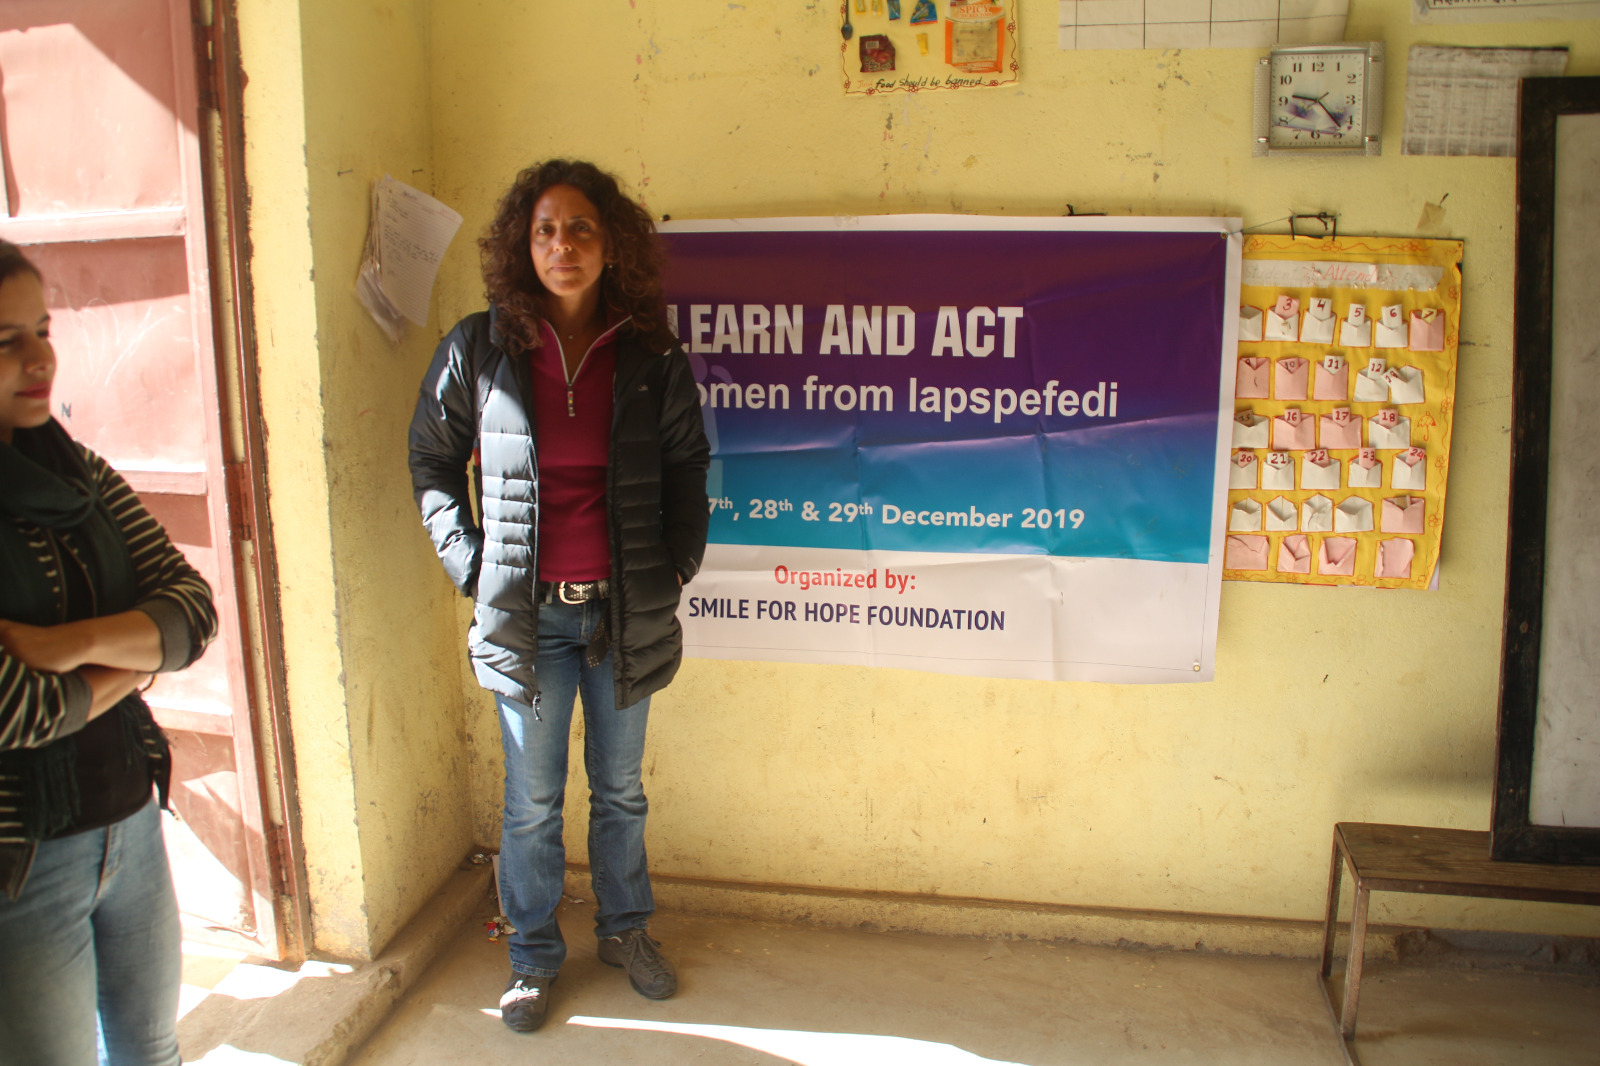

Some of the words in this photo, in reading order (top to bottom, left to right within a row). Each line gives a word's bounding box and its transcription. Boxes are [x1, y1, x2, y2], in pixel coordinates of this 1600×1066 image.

[1293, 62, 1303, 73] 11
[1312, 61, 1325, 72] 12
[876, 78, 896, 89] food
[899, 73, 928, 87] should
[930, 76, 941, 86] be
[1280, 74, 1293, 85] 10
[1347, 73, 1357, 84] 2
[1278, 96, 1289, 106] 9
[1346, 95, 1356, 105] 3
[1345, 115, 1354, 125] 4
[1292, 129, 1302, 140] 7
[1311, 129, 1320, 140] 6
[1282, 298, 1293, 311] 3
[1316, 299, 1327, 312] 4
[1354, 306, 1364, 318] 5
[1389, 307, 1398, 318] 6
[819, 304, 916, 356] AND
[931, 305, 1025, 358] ACT
[1371, 362, 1383, 373] 12
[803, 374, 894, 412] from
[909, 377, 1119, 423] lapspefedi
[1286, 411, 1298, 422] 16
[1335, 410, 1350, 421] 17
[1382, 411, 1396, 423] 18
[1239, 453, 1253, 464] 20
[1270, 453, 1288, 464] 21
[1310, 450, 1326, 462] 22
[1363, 451, 1376, 462] 23
[1409, 448, 1425, 461] 24
[709, 497, 740, 522] 7th,
[749, 498, 794, 520] 28th
[801, 501, 821, 521] &
[828, 502, 874, 523] 29th
[882, 504, 1014, 528] December
[1020, 507, 1086, 530] 2019
[774, 564, 878, 591] Organized
[885, 568, 917, 595] by:
[688, 596, 750, 620] SMILE
[757, 600, 798, 621] FOR
[804, 602, 861, 624] HOPE
[867, 605, 1006, 632] FOUNDATION
